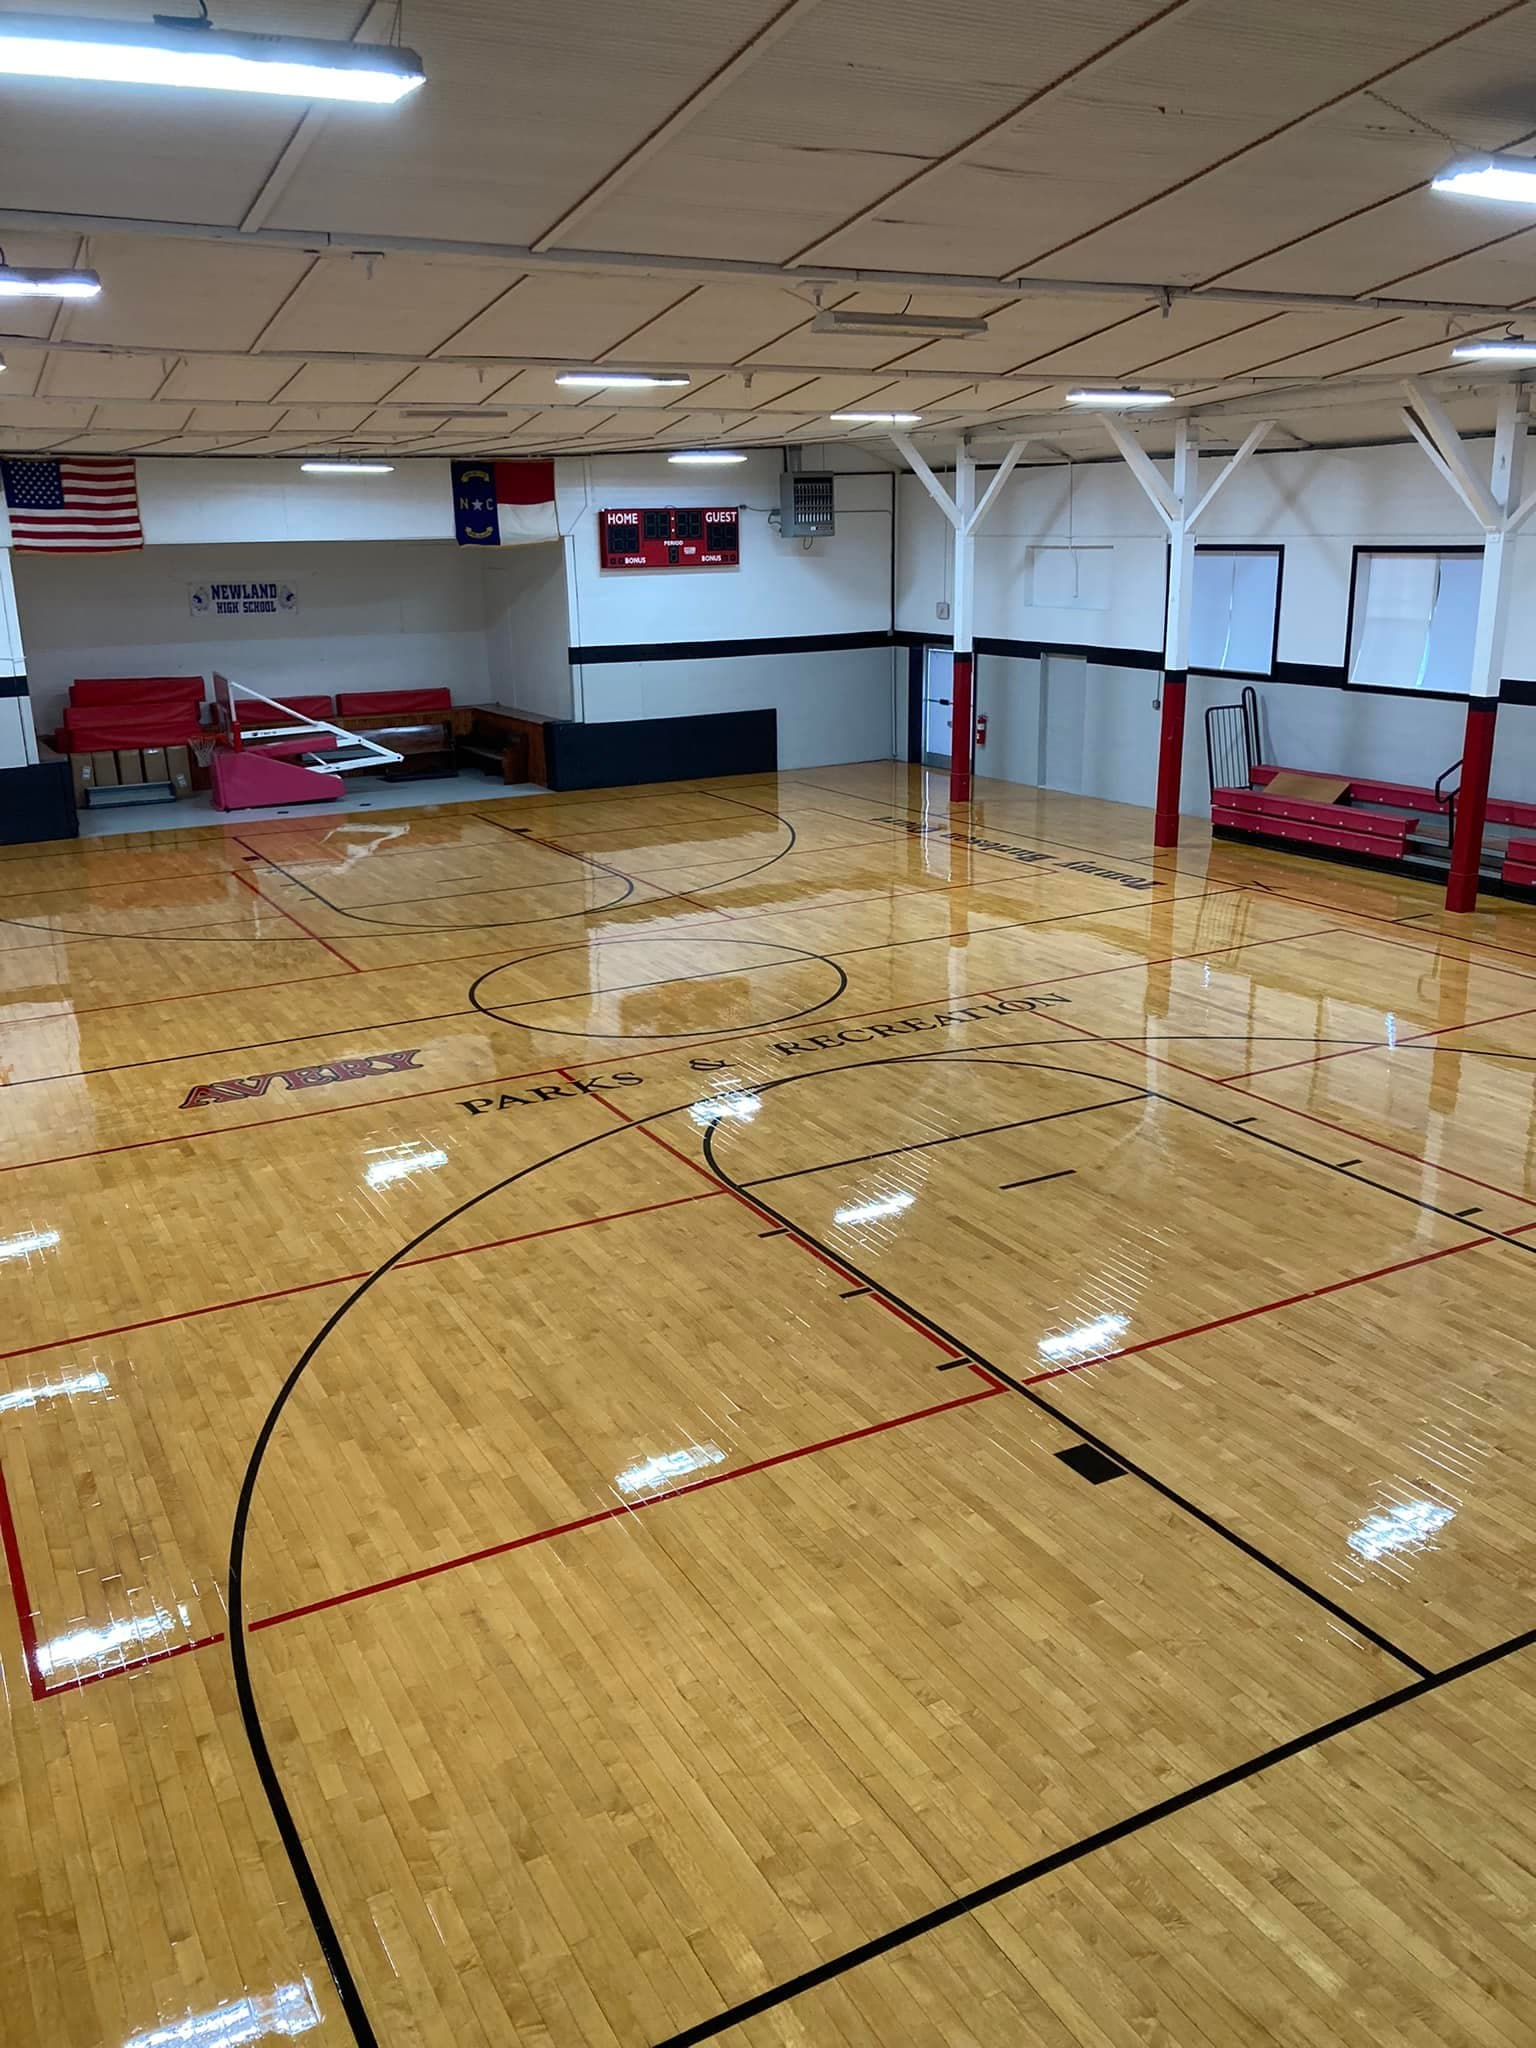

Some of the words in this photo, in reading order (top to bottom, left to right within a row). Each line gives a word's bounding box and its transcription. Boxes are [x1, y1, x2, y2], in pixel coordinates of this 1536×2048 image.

[460, 498, 469, 510] N
[486, 498, 494, 510] C
[607, 513, 639, 525] HOME
[705, 511, 737, 523] GUEST
[624, 556, 646, 564] BONUS
[701, 554, 722, 562] BONUS
[211, 584, 277, 600] NEWLAND
[216, 601, 239, 614] HIGH
[243, 600, 276, 613] SCHOOL
[1053, 860, 1168, 890] Tommy
[456, 1071, 643, 1115] PARKS
[689, 1058, 735, 1071] &
[772, 992, 1072, 1056] RECREATION
[178, 1049, 424, 1109] AVERY
